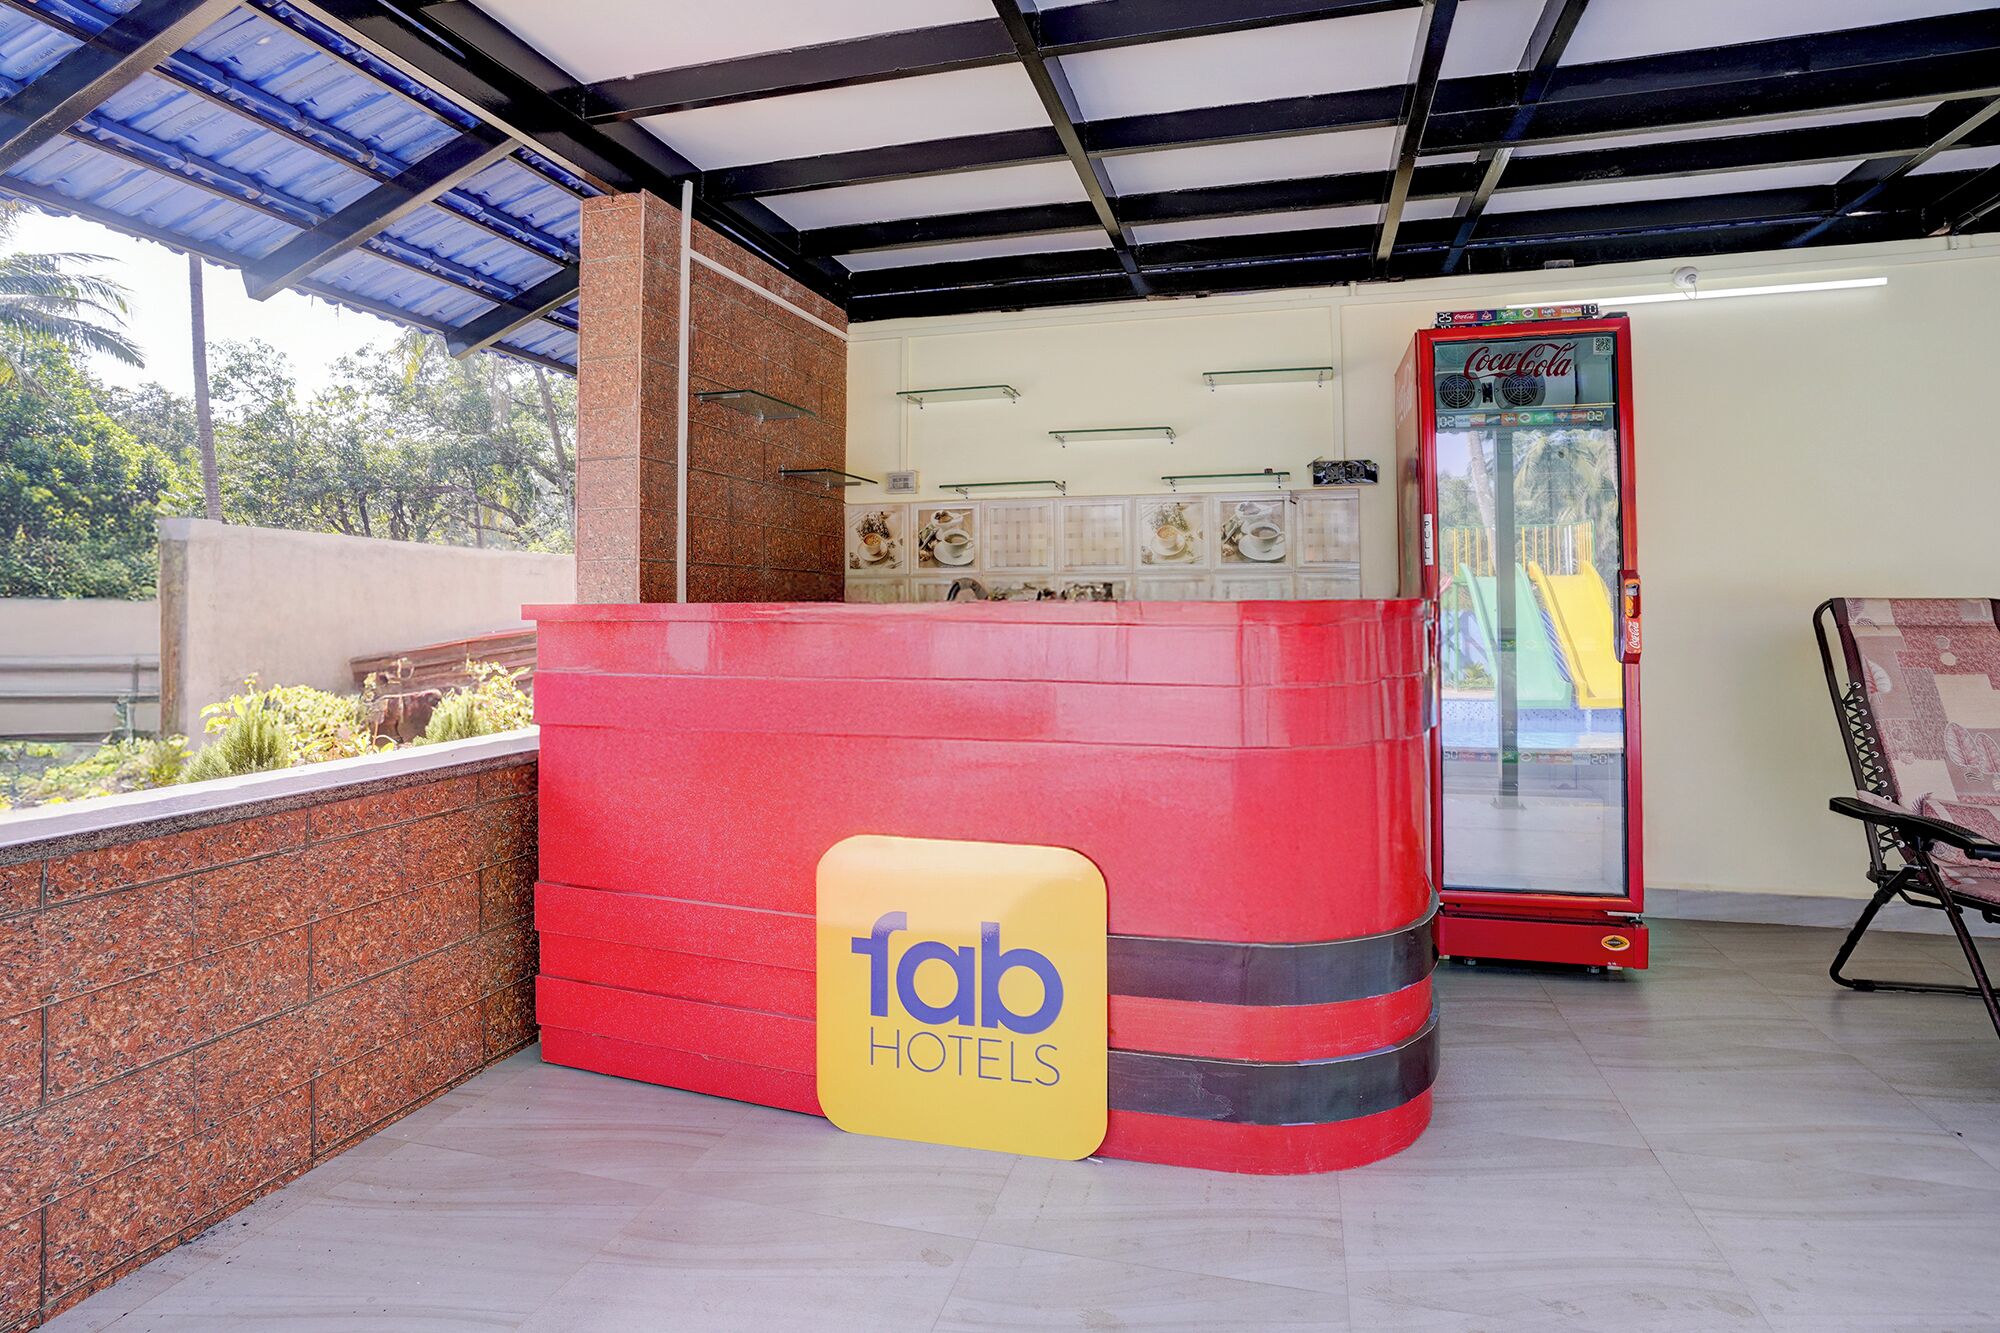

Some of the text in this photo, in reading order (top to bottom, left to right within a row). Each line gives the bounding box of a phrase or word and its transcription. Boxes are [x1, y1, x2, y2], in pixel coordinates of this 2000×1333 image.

[1438, 312, 1452, 323] 25
[1583, 304, 1598, 314] 10
[1464, 342, 1578, 381] Coca-Cola
[851, 911, 1064, 1034] fab
[870, 1026, 1060, 1086] HOTELS
